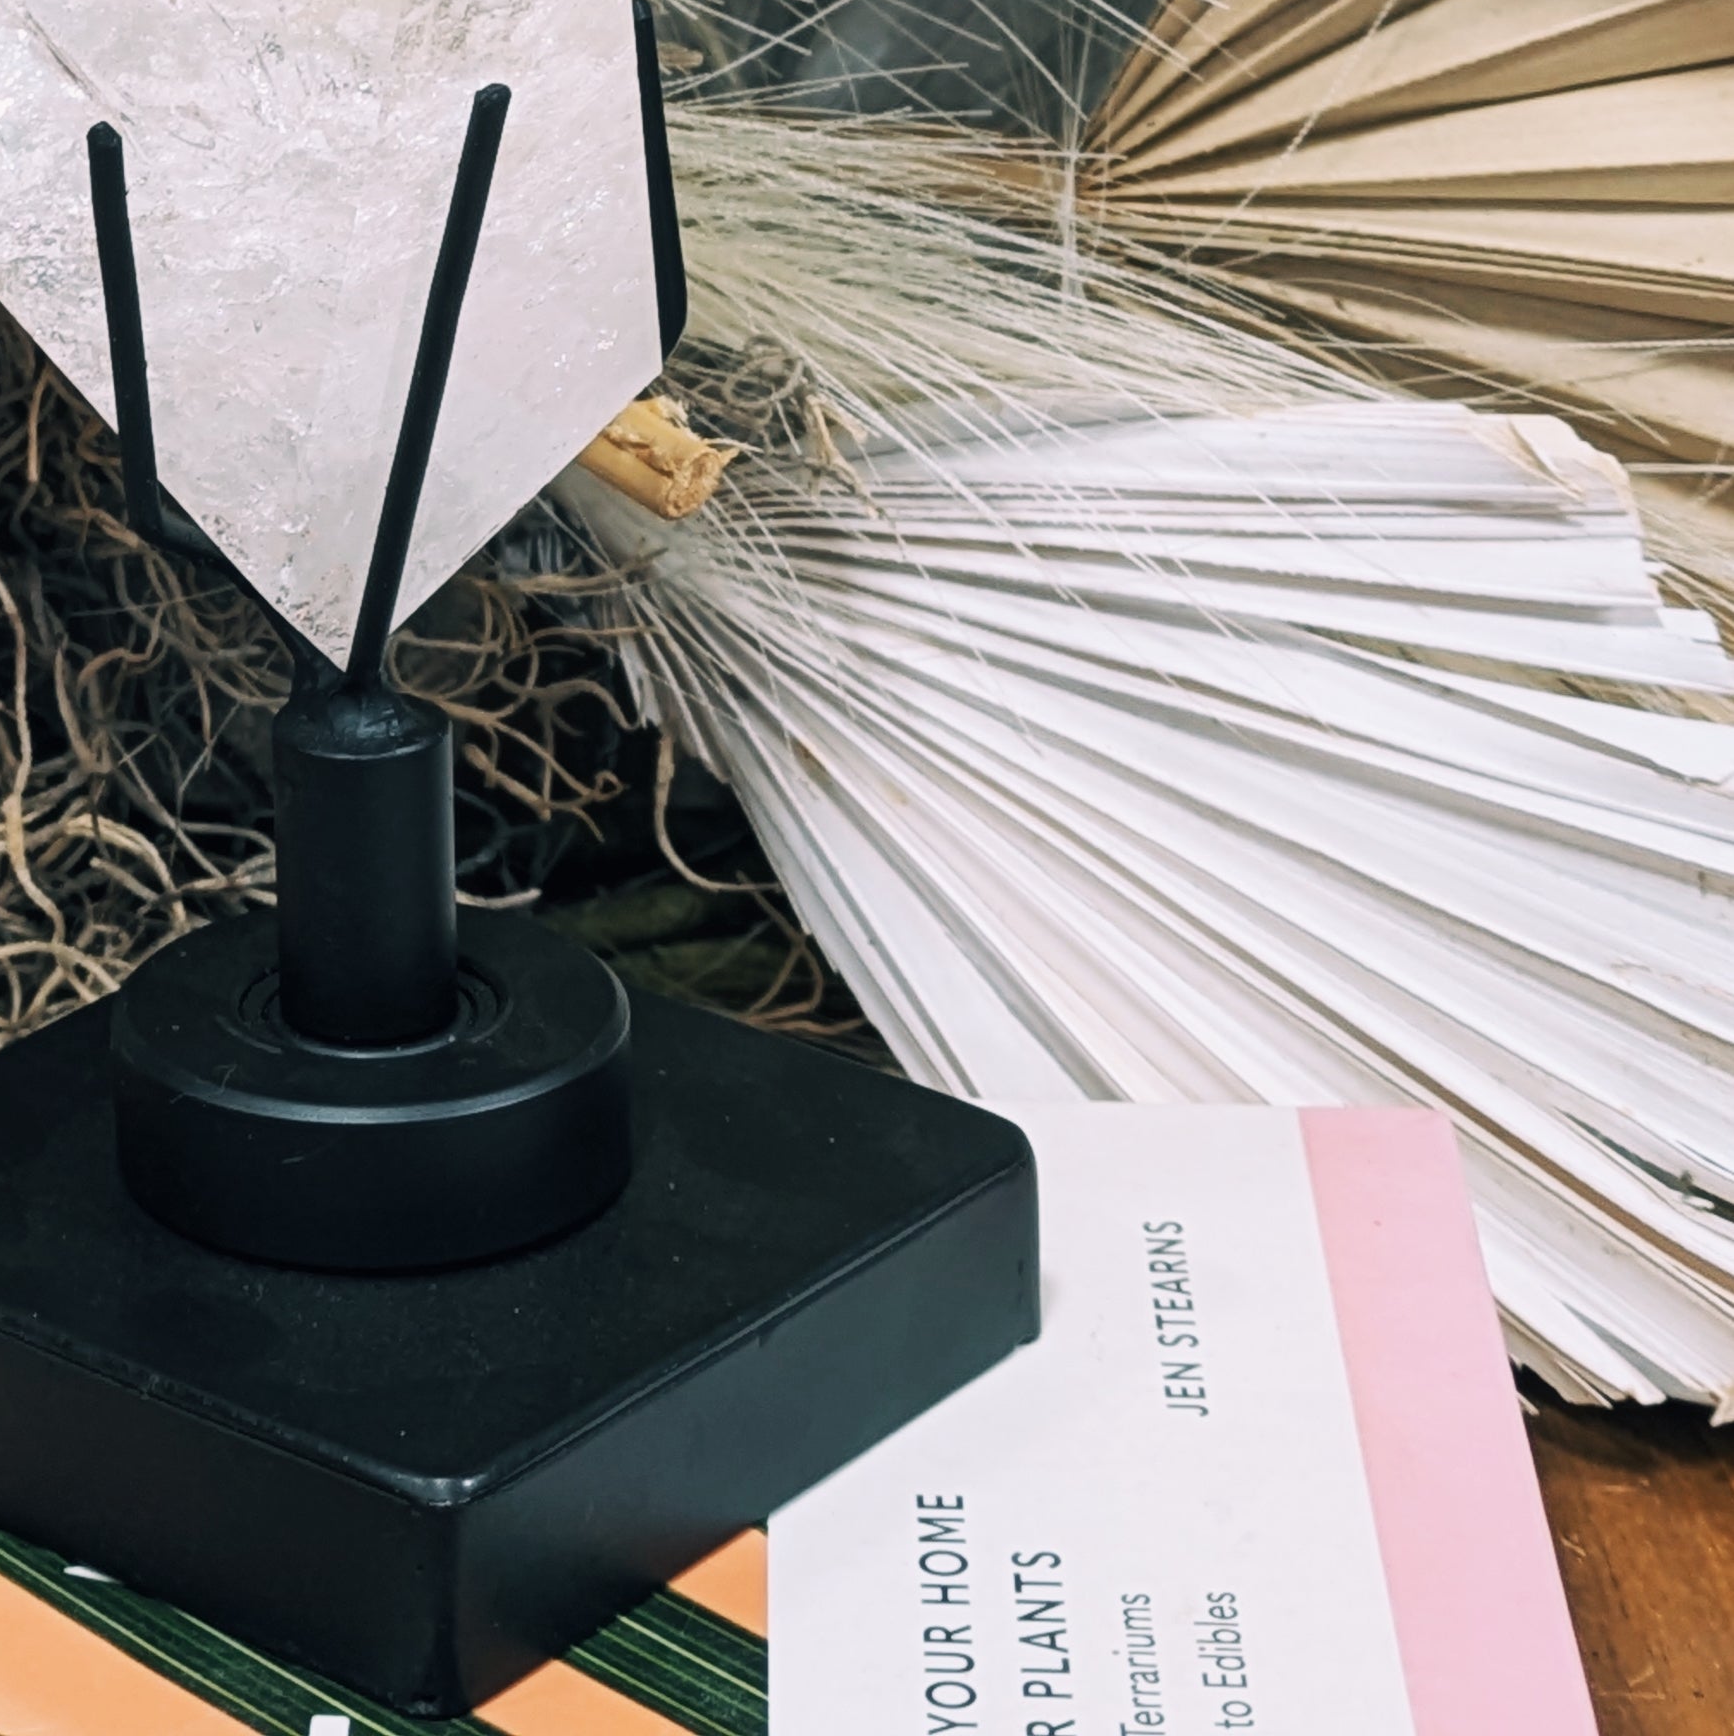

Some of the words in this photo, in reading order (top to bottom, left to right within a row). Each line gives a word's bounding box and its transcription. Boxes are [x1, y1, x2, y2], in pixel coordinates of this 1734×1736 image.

[1142, 1220, 1200, 1349] STEARNS
[1159, 1362, 1210, 1418] JEN
[916, 1494, 970, 1605] HOME
[924, 1624, 978, 1735] YOUR
[1010, 1550, 1074, 1700] PLANTS
[1112, 1593, 1166, 1736] Terrariums
[1193, 1592, 1248, 1689] Edibles
[1214, 1700, 1255, 1729] to
